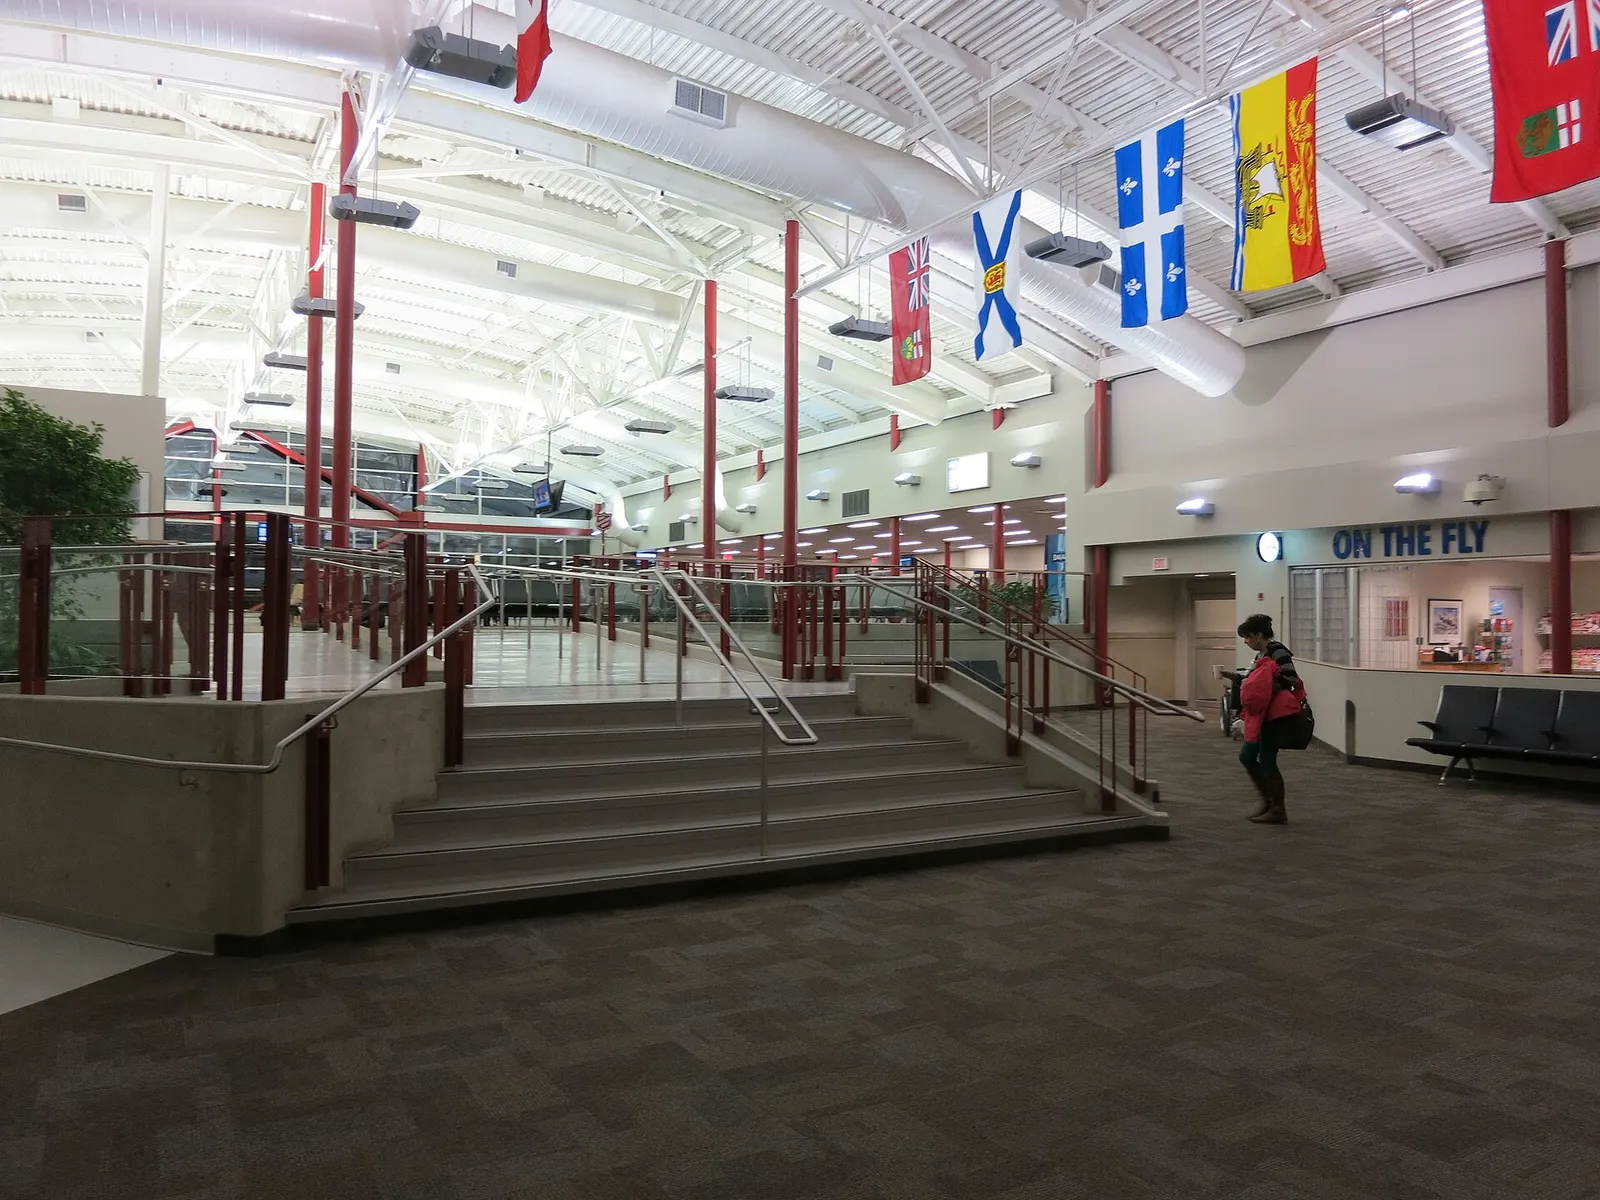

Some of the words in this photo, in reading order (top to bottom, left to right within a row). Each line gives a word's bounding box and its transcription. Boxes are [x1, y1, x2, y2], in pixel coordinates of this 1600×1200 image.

[1333, 528, 1371, 560] ON
[1380, 524, 1432, 557] THE
[1441, 520, 1489, 554] FLY
